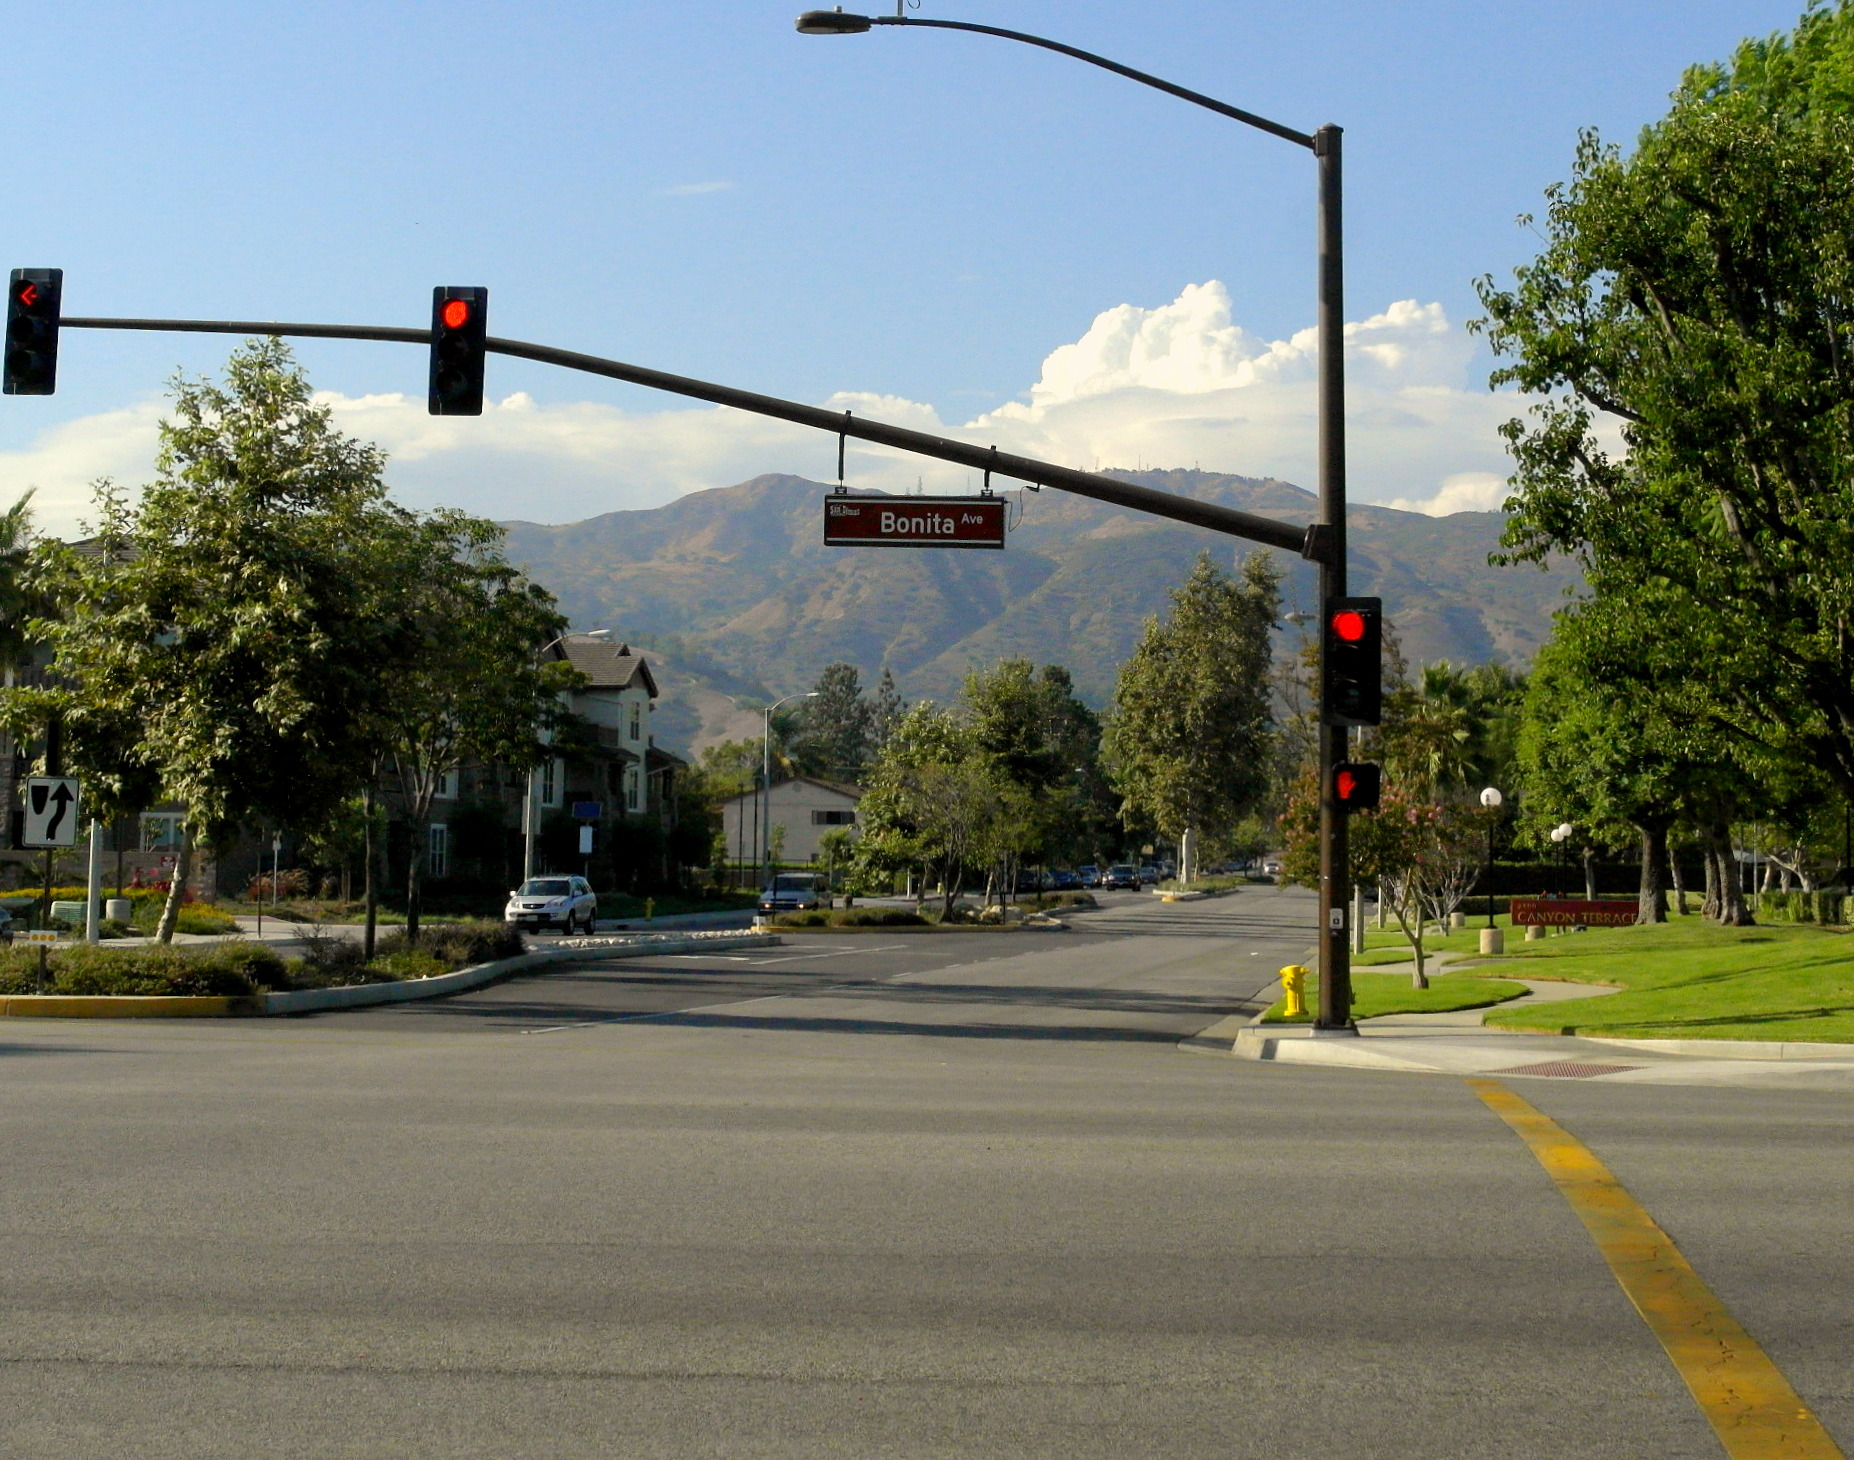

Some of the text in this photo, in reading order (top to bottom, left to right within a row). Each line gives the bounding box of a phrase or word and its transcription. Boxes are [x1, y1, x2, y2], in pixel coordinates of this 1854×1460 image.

[880, 511, 983, 534] Bonita Ave
[1517, 911, 1576, 923] CANYON
